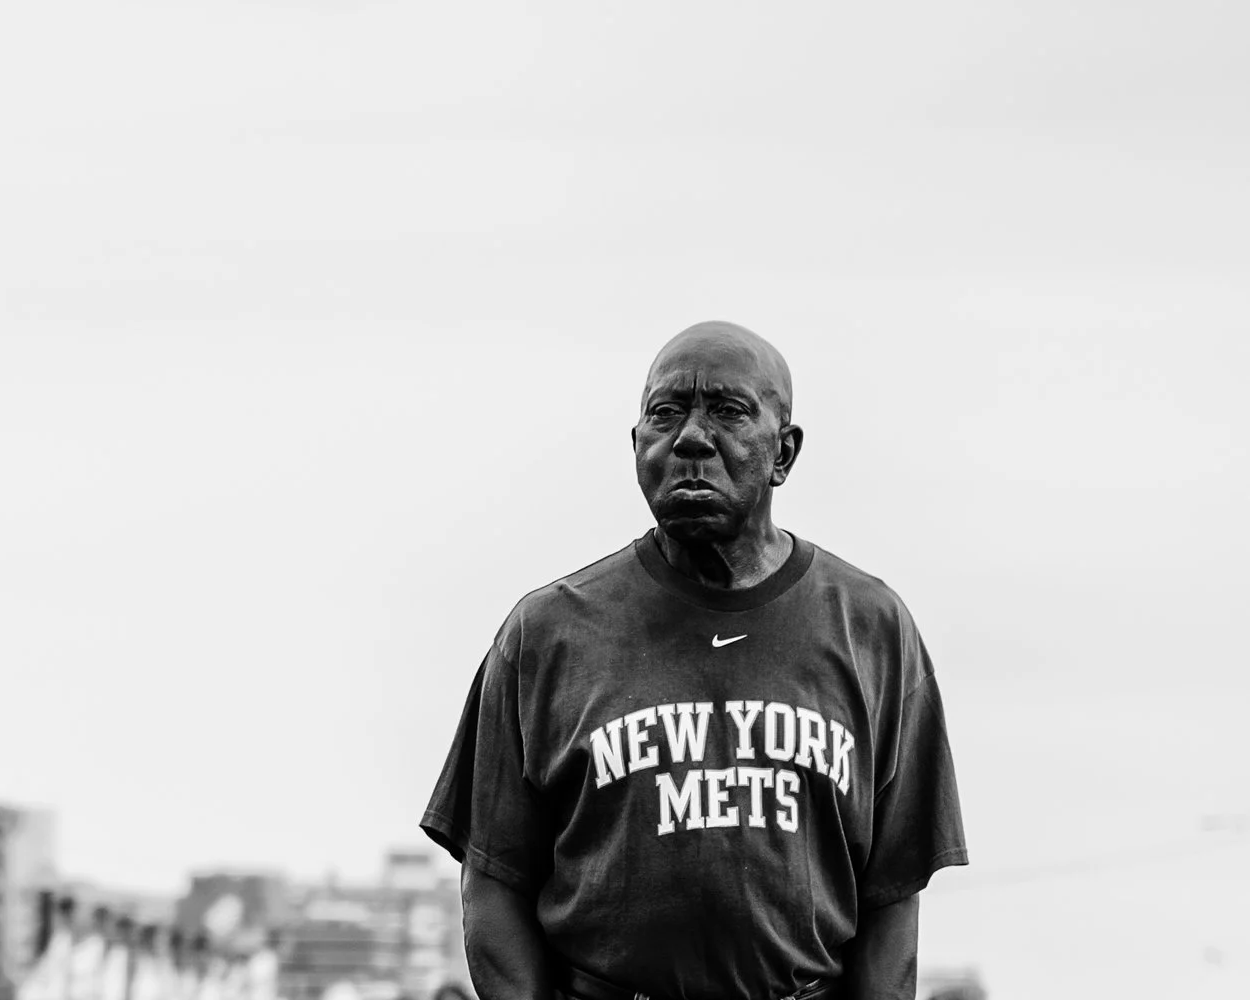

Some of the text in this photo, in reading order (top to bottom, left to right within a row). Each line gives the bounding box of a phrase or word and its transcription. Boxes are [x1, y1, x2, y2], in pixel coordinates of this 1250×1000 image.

[589, 700, 856, 796] NEW YORK
[655, 766, 801, 836] METS
